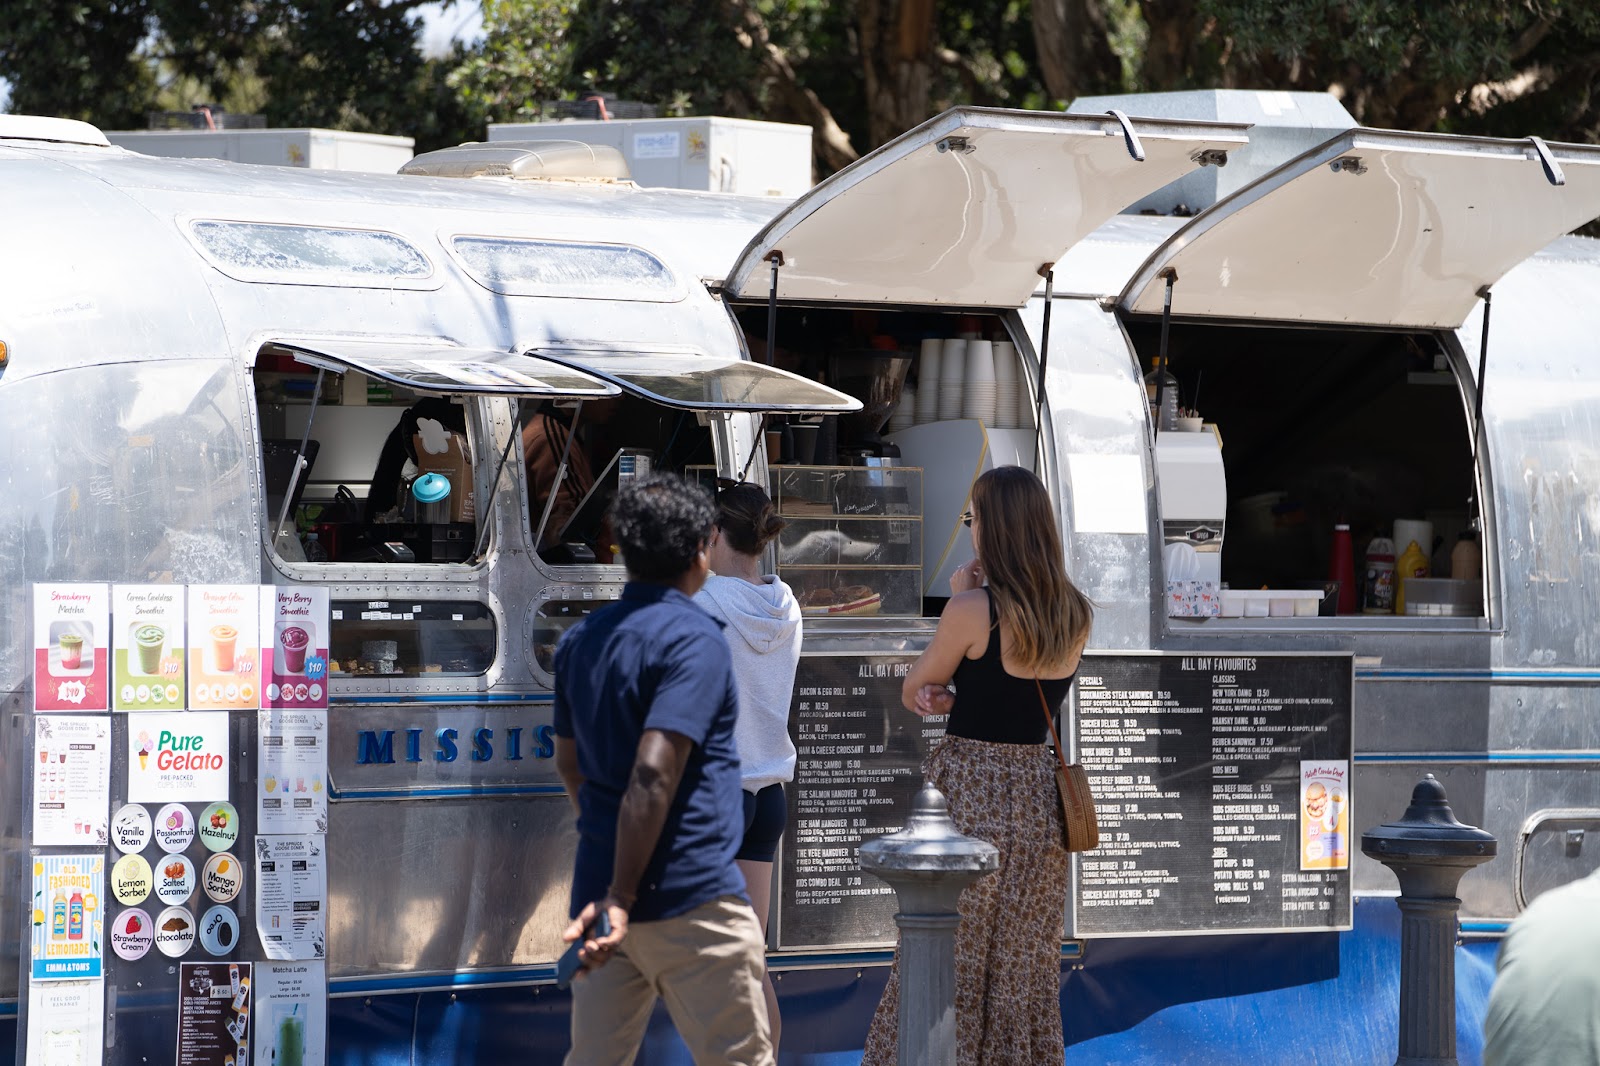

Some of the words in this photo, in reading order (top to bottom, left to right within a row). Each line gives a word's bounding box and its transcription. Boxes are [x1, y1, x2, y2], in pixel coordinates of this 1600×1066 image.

[51, 591, 91, 605] Strawberry
[278, 593, 293, 605] Very
[293, 592, 312, 606] Berry
[58, 604, 85, 614] Matcha
[135, 605, 165, 615] Smoothie
[280, 606, 309, 616] Smoothie
[164, 663, 179, 674] $10
[238, 662, 253, 674] $10
[308, 662, 322, 674] $10
[1181, 658, 1195, 671] ALL
[1198, 658, 1211, 671] DAY
[1214, 658, 1256, 671] FAVOURITES
[858, 664, 874, 677] ALL
[877, 664, 892, 677] DAY
[1079, 676, 1103, 685] SPECIALS
[1212, 675, 1236, 683] CLASSICS
[800, 687, 817, 696] BACON
[822, 688, 832, 696] EGG
[833, 687, 846, 695] ROLL
[852, 687, 866, 695] 10.50
[1112, 691, 1128, 699] STEAK
[1128, 691, 1153, 699] SANDWICH
[1212, 689, 1224, 697] NEW
[1224, 689, 1237, 697] YORK
[1237, 689, 1252, 697] DAWG
[799, 702, 810, 710] ABC
[815, 702, 829, 710] 10.50
[1080, 719, 1100, 728] CHICKEN
[1101, 719, 1119, 728] DELUXE
[1212, 717, 1234, 725] KRANSKY
[1234, 717, 1249, 725] DAWG
[799, 724, 809, 732] BLT
[814, 724, 828, 732] 10.50
[157, 730, 204, 751] Pure
[1212, 738, 1232, 746] REUBEN
[1231, 738, 1256, 746] SANDWICH
[1260, 738, 1274, 746] 17.50
[798, 746, 811, 755] HAM
[815, 746, 835, 754] CHEESE
[836, 745, 864, 754] CROISSANT
[869, 745, 883, 753] 10.00
[157, 750, 224, 771] Gelato
[799, 761, 809, 769] THE
[809, 760, 823, 769] SNAG
[824, 760, 841, 769] SAMBO
[1212, 766, 1224, 774] KIDS
[1224, 766, 1238, 774] MENU
[1101, 776, 1114, 784] BEEF
[1114, 776, 1133, 784] BURGER
[1212, 784, 1224, 793] KIDS
[1225, 784, 1237, 792] BEEF
[1260, 784, 1272, 792] 9.50
[798, 790, 808, 799] THE
[809, 790, 831, 798] SALMON
[831, 789, 857, 798] HANGOVER
[862, 789, 877, 797] 17.00
[1213, 805, 1224, 813] KIDS
[1225, 805, 1245, 813] CHICKEN
[797, 819, 808, 828] THE
[808, 819, 820, 828] HAM
[821, 819, 847, 828] HANGOVER
[116, 826, 145, 836] Vanilla
[156, 829, 195, 837] Passionfruit
[201, 826, 235, 841] Hazelnut
[1213, 826, 1224, 834] KIDS
[1225, 826, 1239, 834] DAWG
[1243, 826, 1255, 834] 9.50
[120, 837, 141, 846] Bean
[164, 837, 187, 845] Cream
[797, 849, 807, 857] THE
[808, 848, 821, 857] VEGE
[822, 848, 849, 857] HANGOVER
[1212, 847, 1228, 856] SIDES
[1082, 862, 1099, 870] VEGGIE
[1100, 862, 1118, 870] BURGER
[1213, 859, 1223, 868] HOT
[1224, 859, 1238, 868] CHIPS
[63, 866, 77, 874] OLD
[1214, 871, 1232, 879] POTATO
[1234, 870, 1254, 879] WEDGES
[163, 878, 185, 887] Salted
[207, 872, 235, 887] Mango
[796, 879, 808, 887] KIDS
[808, 878, 827, 887] COMBO
[828, 878, 841, 886] DEAL
[847, 877, 861, 886] 17.00
[1282, 874, 1297, 882] EXTRA
[1298, 874, 1322, 882] HALLOUMI
[118, 879, 146, 887] Lemon
[1214, 883, 1231, 891] SPRING
[1233, 882, 1248, 891] ROLLS
[119, 889, 147, 898] Sorbet
[158, 888, 190, 896] Caramel
[207, 882, 234, 896] Sorbet
[1282, 888, 1297, 897] EXTRA
[1298, 887, 1319, 896] AVOCADO
[1082, 891, 1102, 899] CHICKEN
[1103, 890, 1118, 899] SATAY
[1119, 890, 1142, 898] SKEWERS
[1282, 902, 1297, 911] EXTRA
[1298, 902, 1314, 911] PATTIE
[206, 914, 223, 935] Oreo
[113, 933, 152, 945] Strawberry
[156, 932, 194, 942] chocolate
[120, 943, 144, 951] Cream
